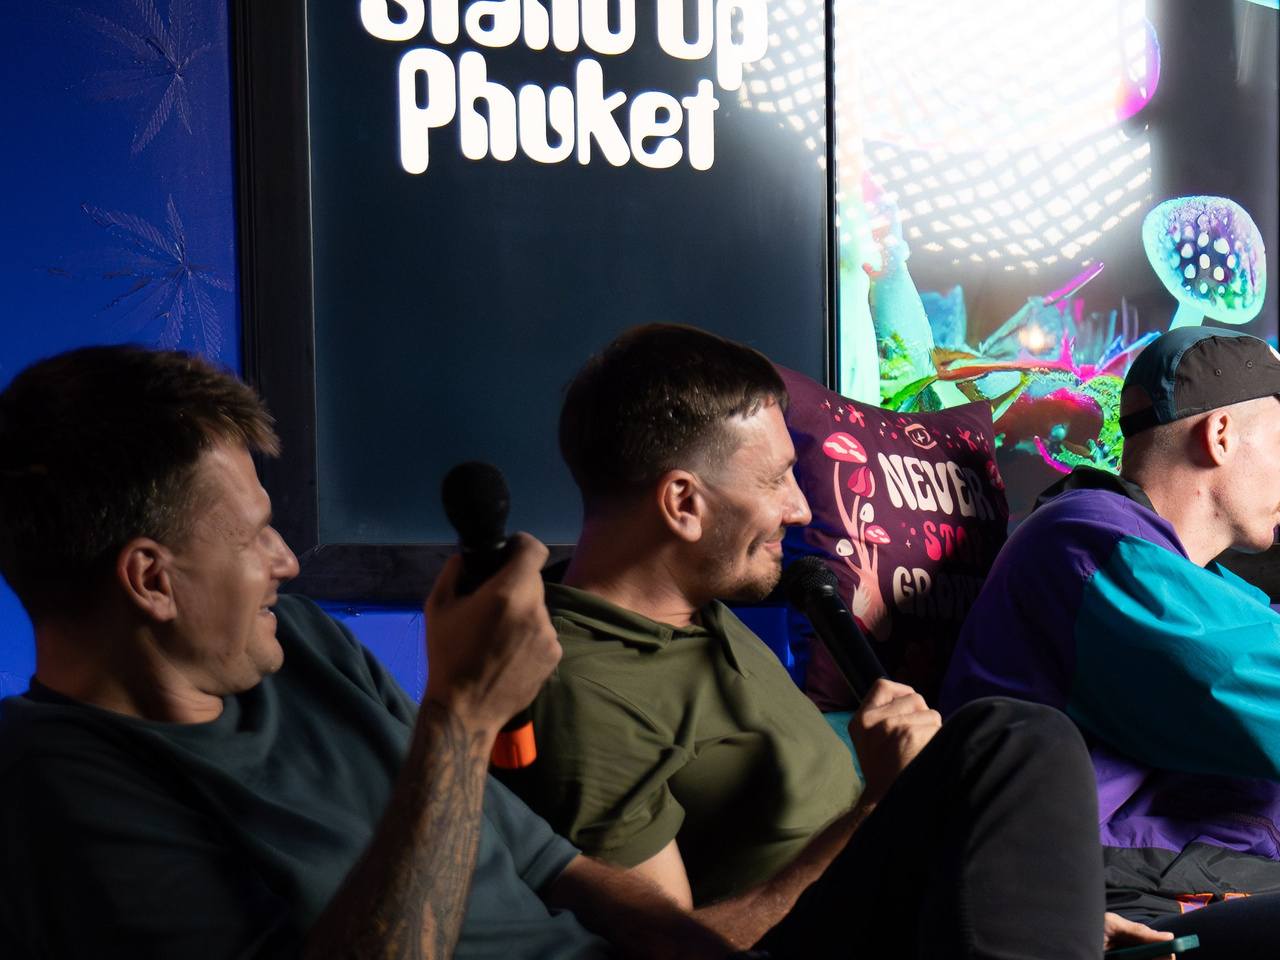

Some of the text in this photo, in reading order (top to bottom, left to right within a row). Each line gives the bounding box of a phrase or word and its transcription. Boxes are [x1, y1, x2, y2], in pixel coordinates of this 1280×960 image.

[657, 0, 769, 91] Up
[398, 47, 720, 174] Phuket
[877, 452, 996, 522] NEVER
